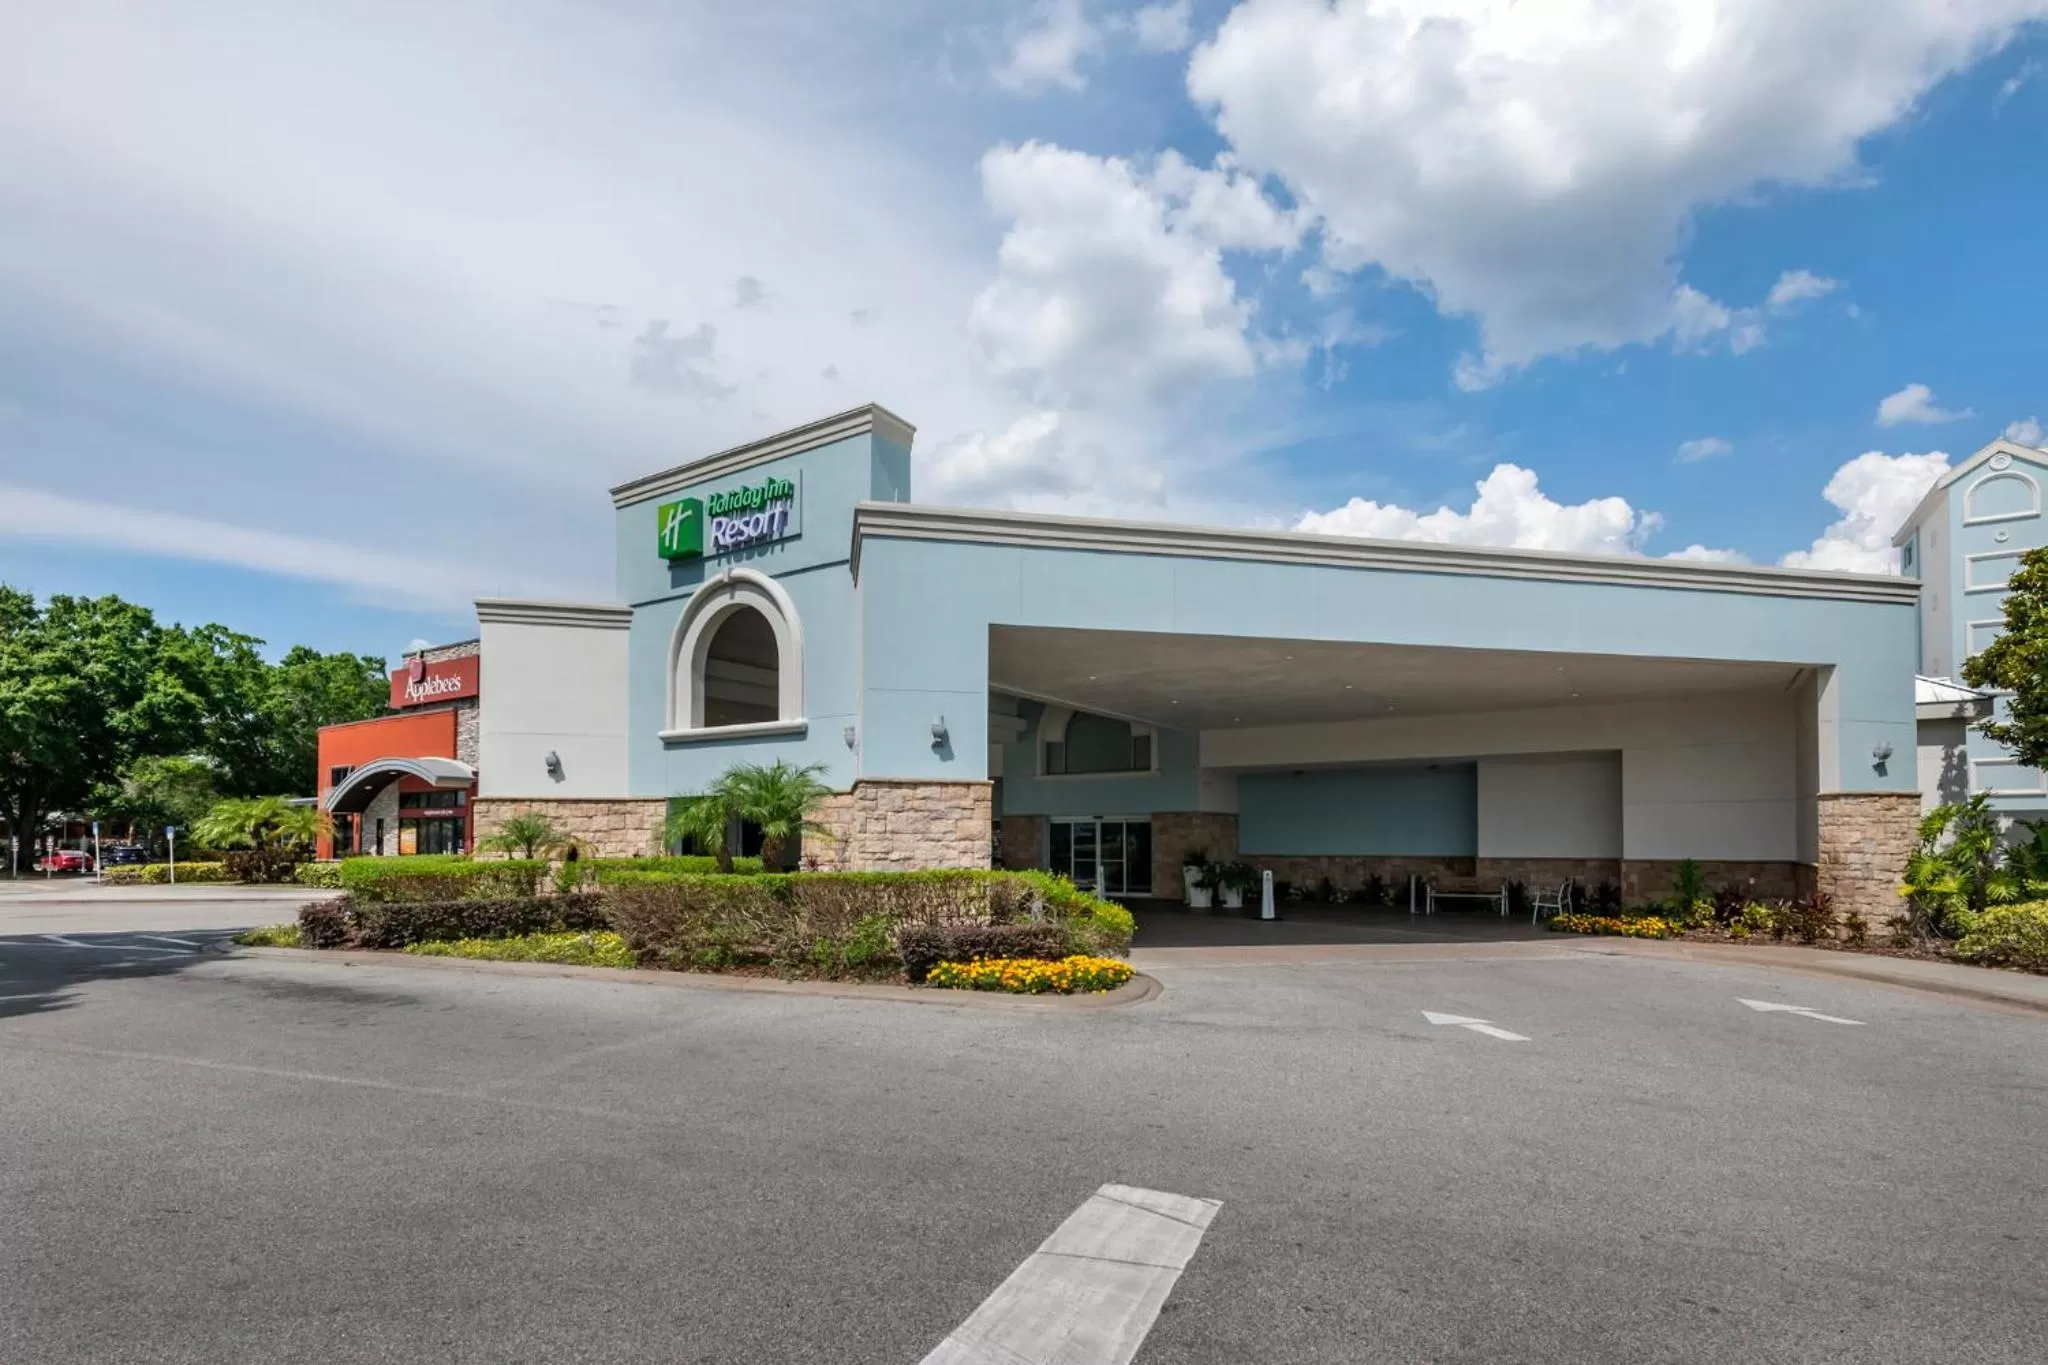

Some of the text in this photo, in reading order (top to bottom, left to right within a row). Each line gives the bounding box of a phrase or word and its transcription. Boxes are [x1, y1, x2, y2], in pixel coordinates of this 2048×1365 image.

[707, 477, 791, 516] Holiday Inn
[711, 501, 785, 548] Resort
[404, 673, 462, 702] Applebee's
